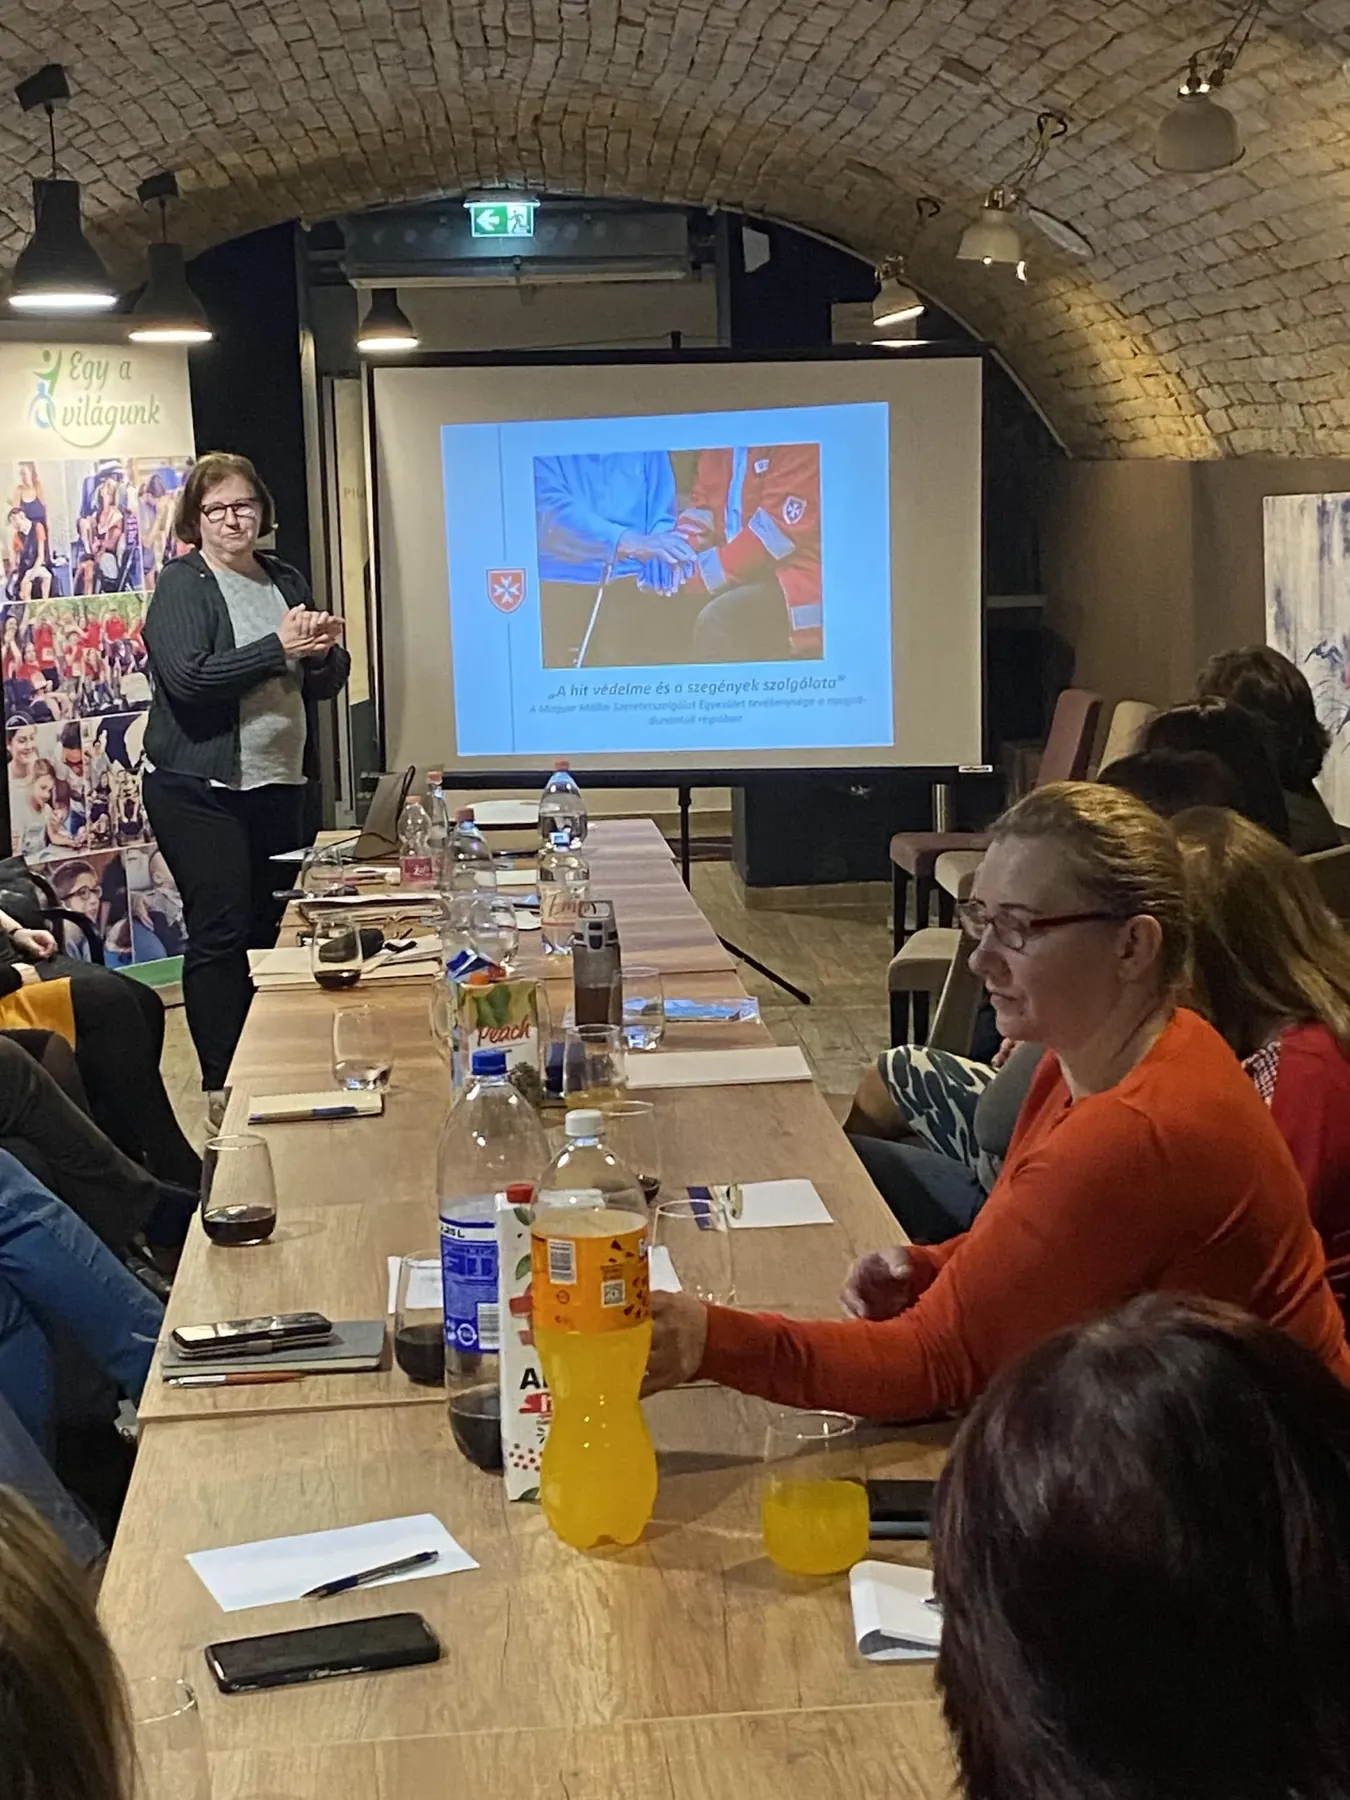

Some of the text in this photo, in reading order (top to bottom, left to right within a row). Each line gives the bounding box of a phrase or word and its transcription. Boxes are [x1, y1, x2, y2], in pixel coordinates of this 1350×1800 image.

[69, 351, 132, 389] Egy a
[62, 394, 160, 427] világunk
[571, 684, 589, 697] hit
[593, 682, 651, 696] védelme
[655, 681, 670, 695] és
[674, 683, 683, 694] a
[687, 679, 759, 695] szegények
